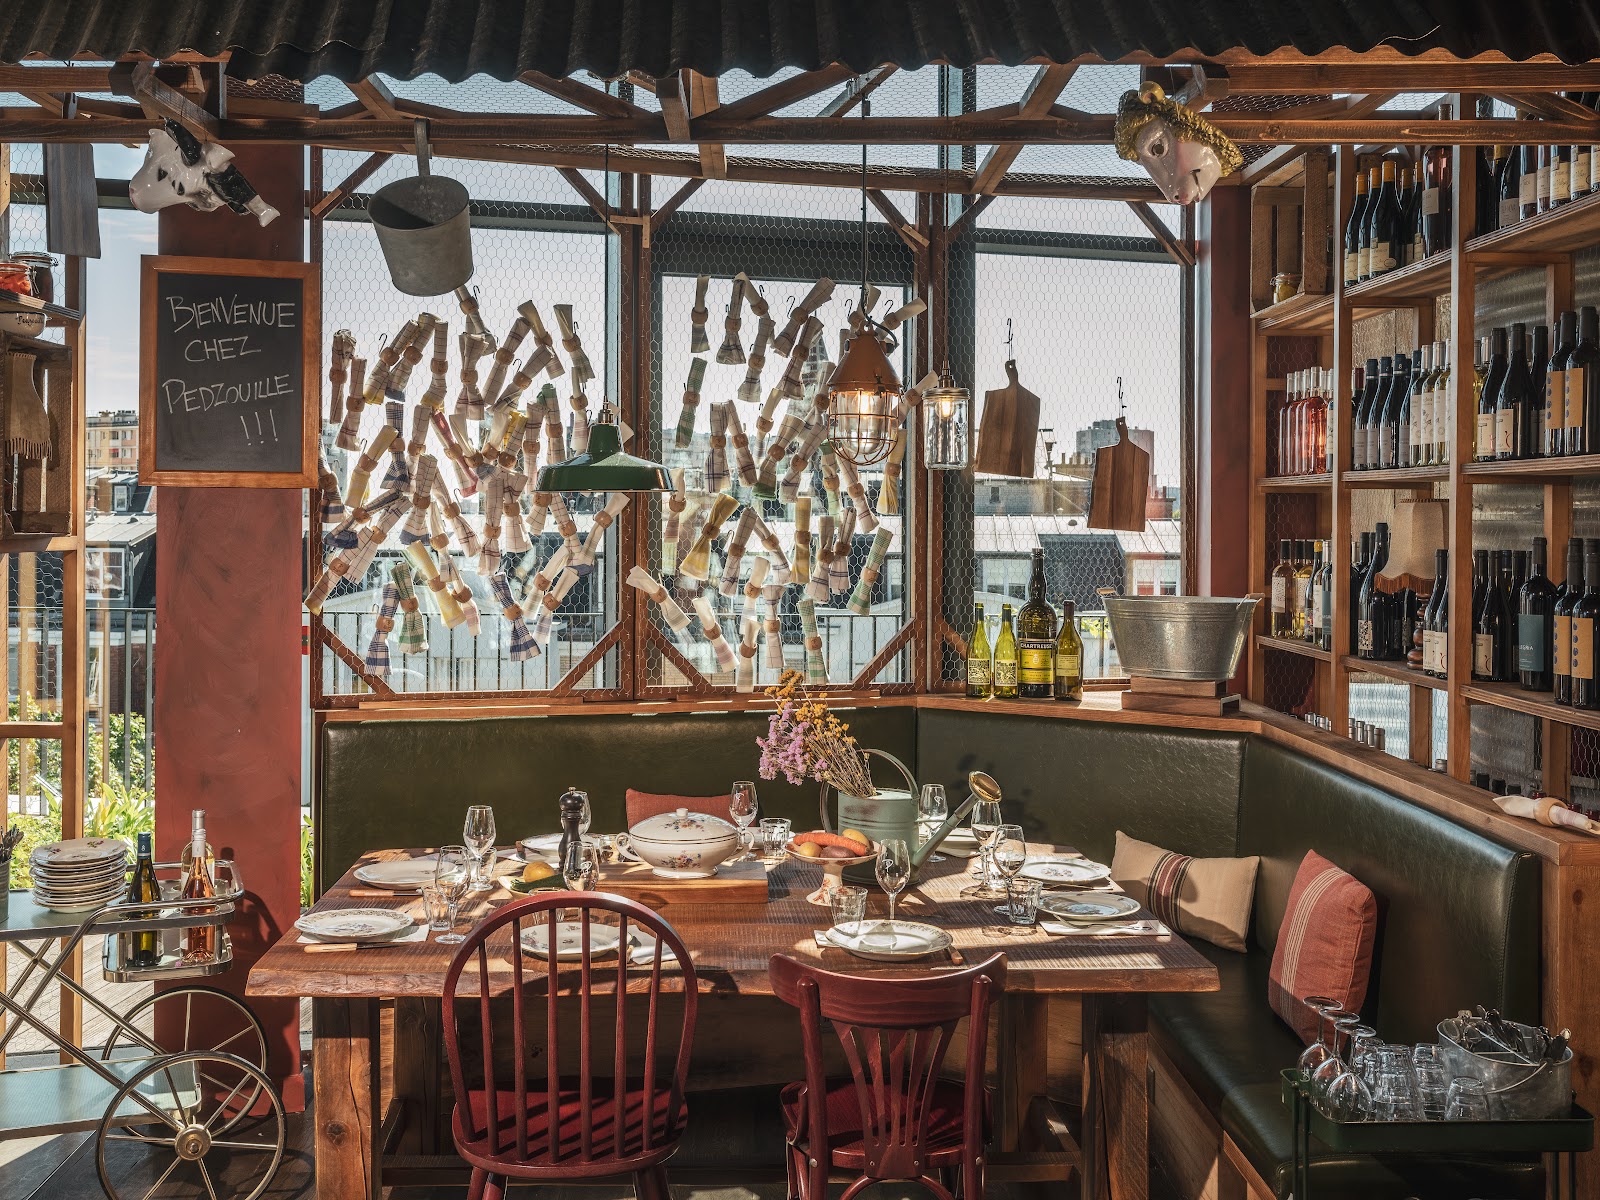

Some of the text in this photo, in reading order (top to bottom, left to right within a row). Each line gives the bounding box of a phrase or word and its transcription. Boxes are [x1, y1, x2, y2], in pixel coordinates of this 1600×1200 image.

[165, 293, 296, 333] BIENVENUE
[184, 335, 262, 363] CHEZ
[161, 373, 295, 415] PEDZOUILLE
[240, 408, 279, 446] !!!
[1020, 642, 1053, 650] CHARTREUSE
